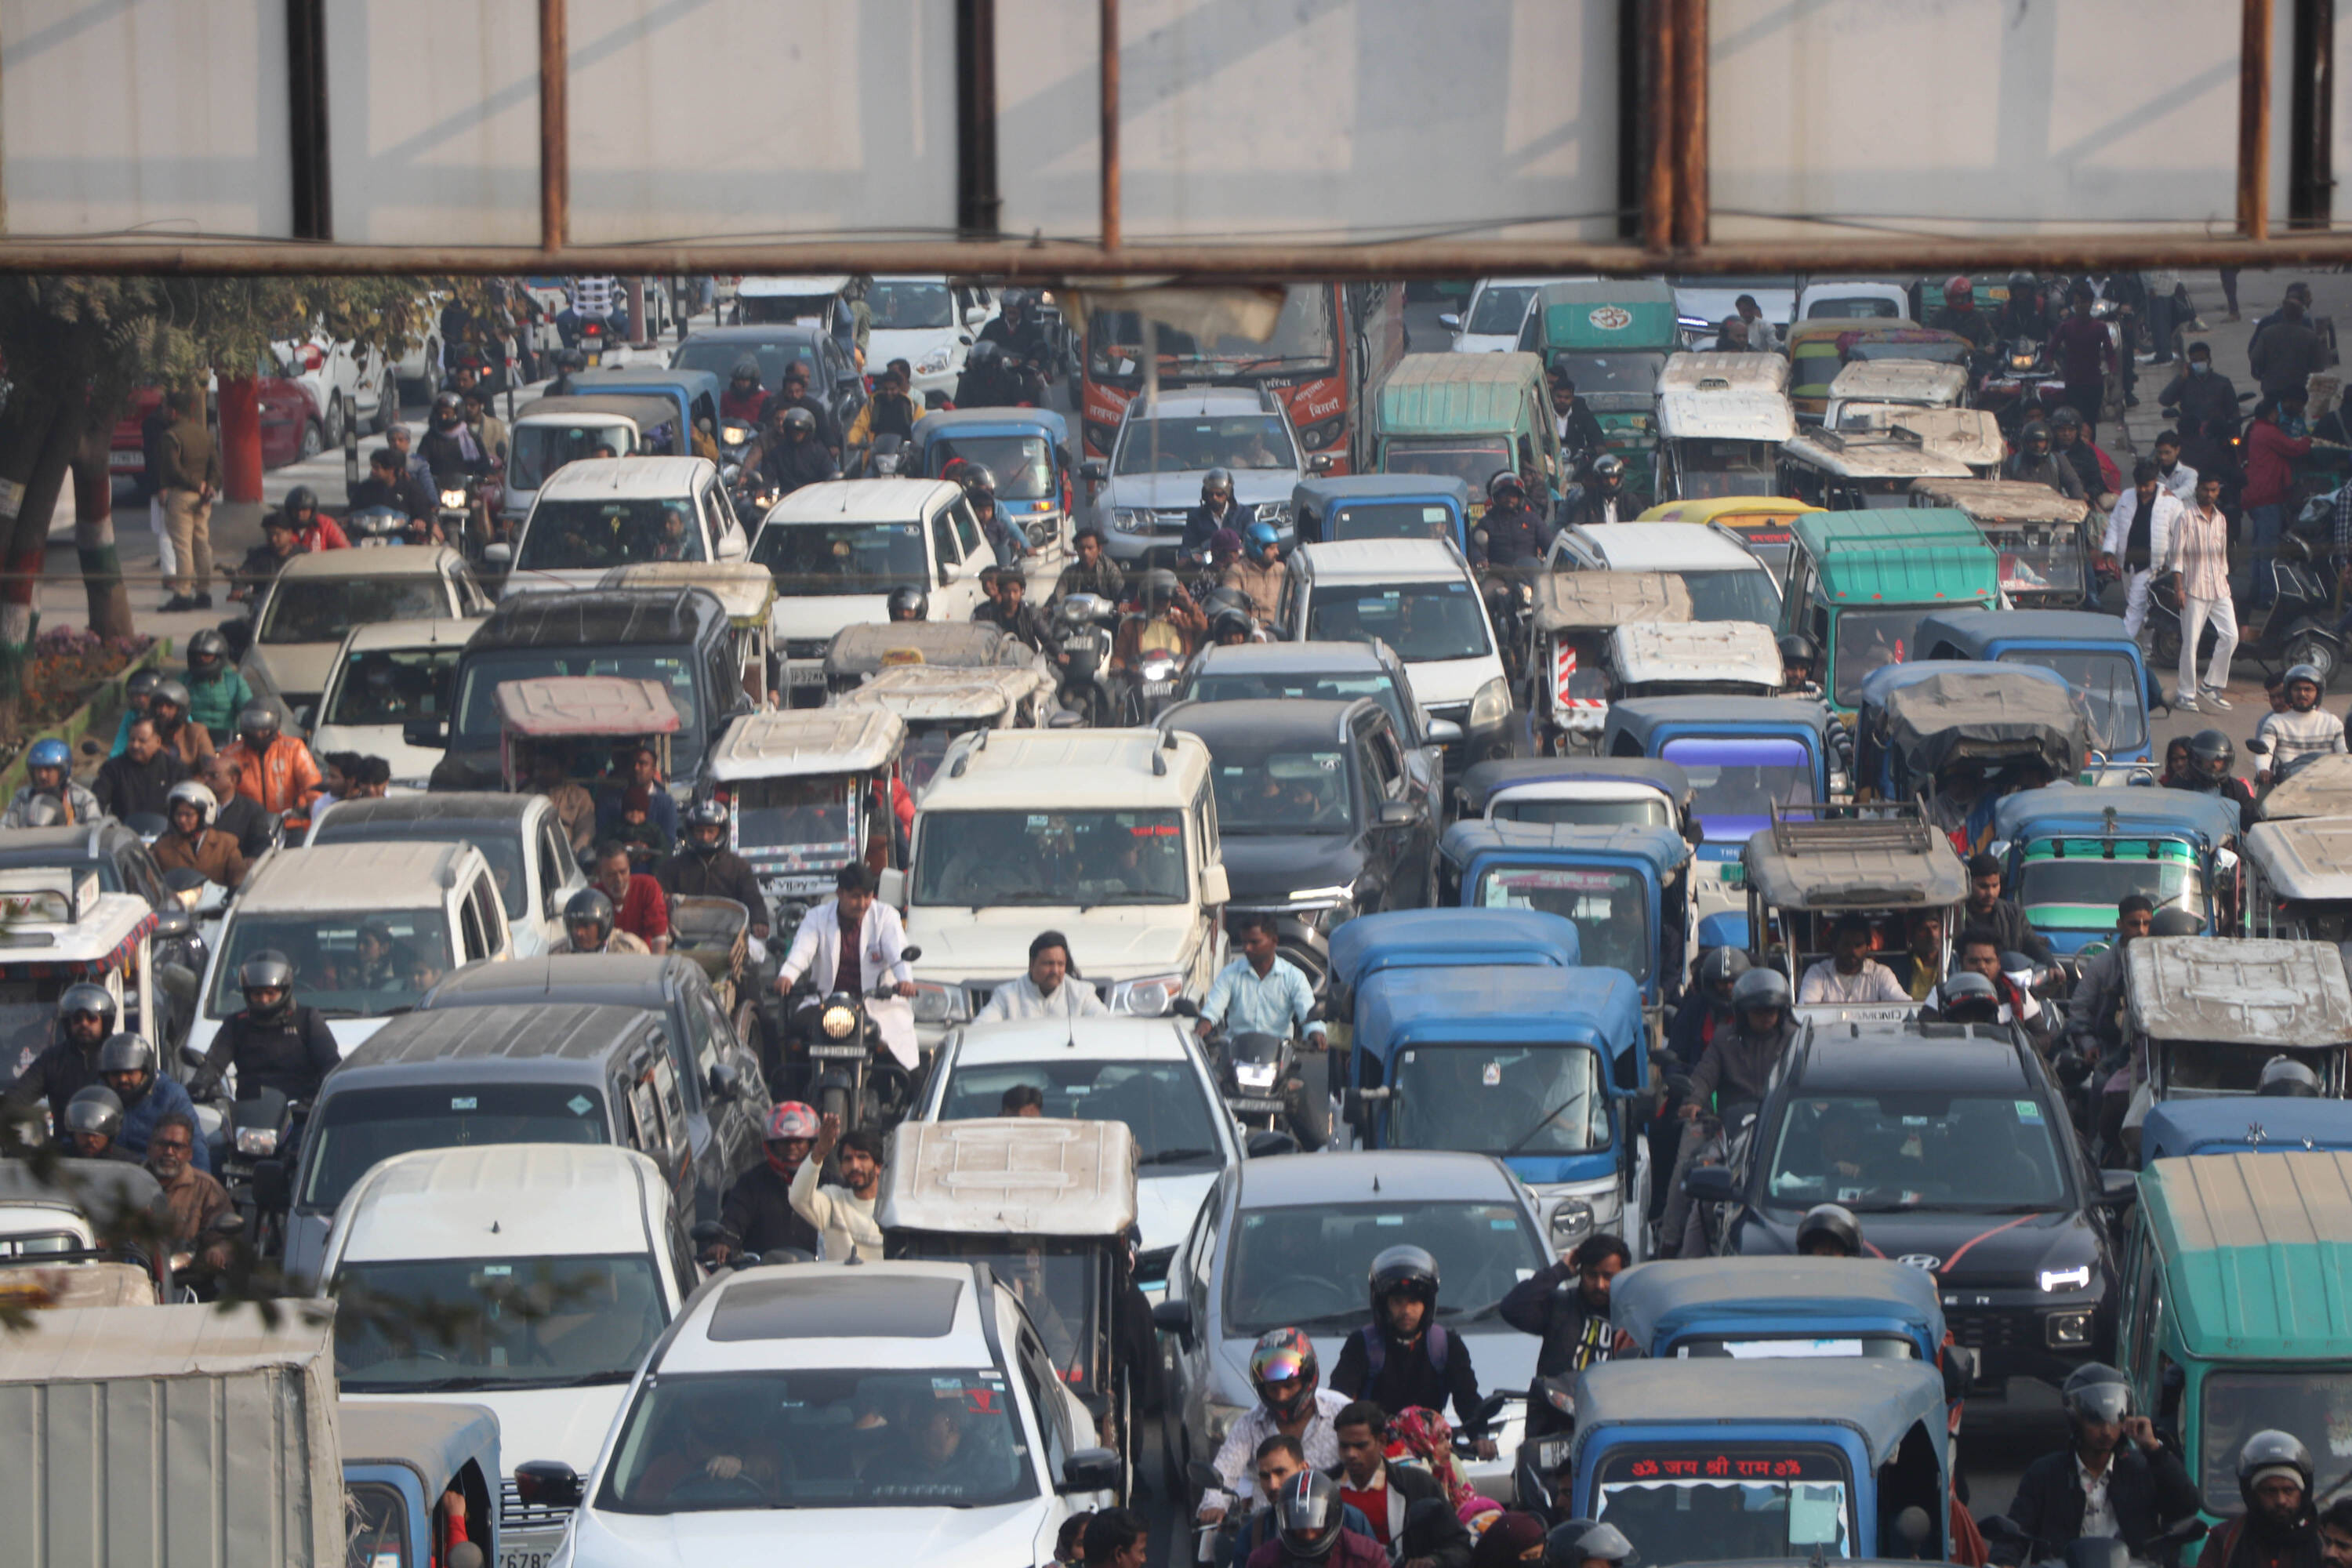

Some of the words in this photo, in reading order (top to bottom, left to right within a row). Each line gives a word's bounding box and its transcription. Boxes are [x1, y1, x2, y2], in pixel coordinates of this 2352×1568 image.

[1663, 1461, 1699, 1475] जय
[1705, 1455, 1730, 1475] श्री
[1737, 1461, 1770, 1475] राम
